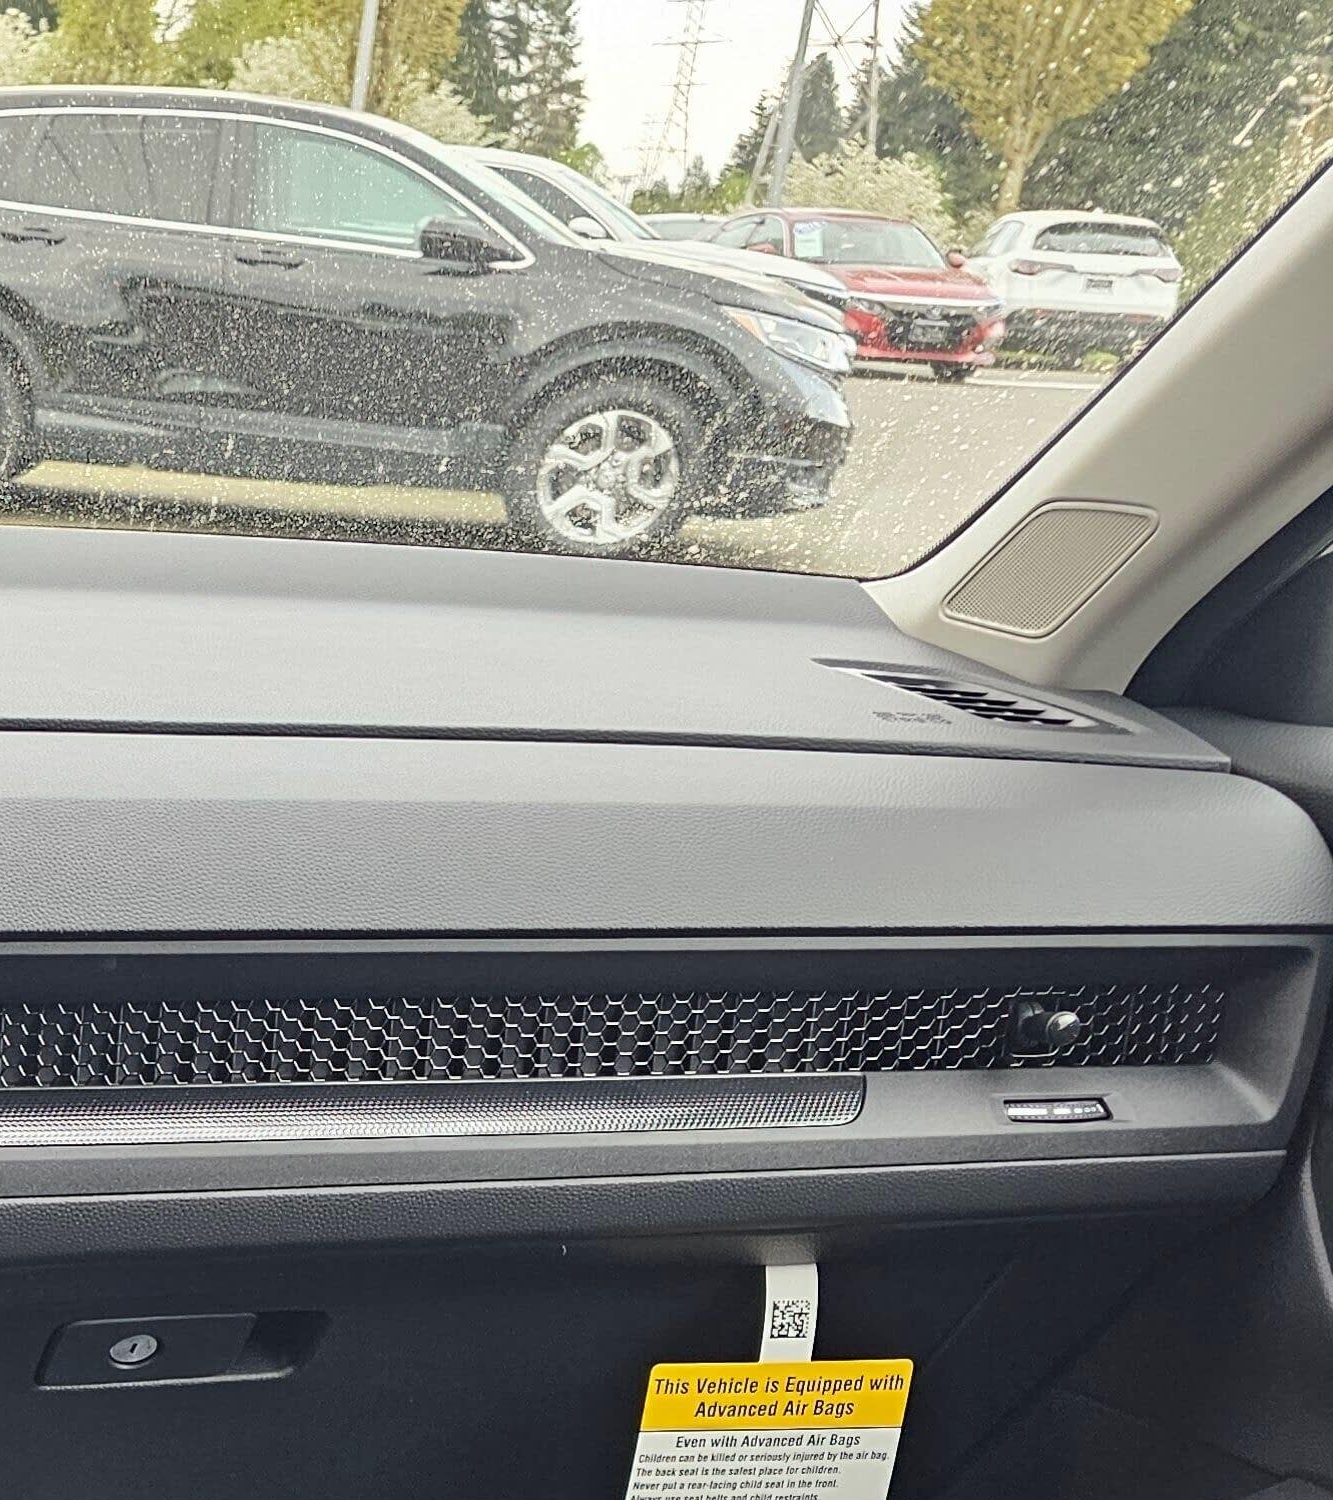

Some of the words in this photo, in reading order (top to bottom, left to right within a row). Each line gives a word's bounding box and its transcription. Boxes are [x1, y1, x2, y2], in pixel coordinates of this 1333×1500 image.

[654, 1378, 689, 1395] This
[696, 1377, 758, 1394] Vehicle
[765, 1377, 779, 1393] is
[785, 1375, 863, 1396] Equipped
[869, 1375, 904, 1391] with
[694, 1401, 777, 1418] Advanced
[783, 1400, 807, 1416] Air
[813, 1399, 854, 1419] Bags
[675, 1436, 707, 1448] Even
[710, 1436, 737, 1447] with
[741, 1434, 804, 1447] Advanced
[807, 1434, 826, 1446] Air
[829, 1434, 861, 1448] Bags
[639, 1453, 677, 1463] Children
[678, 1454, 695, 1463] can
[697, 1453, 708, 1462] be
[711, 1453, 736, 1462] killed
[738, 1453, 747, 1461] or
[750, 1452, 791, 1463] seriously
[793, 1452, 825, 1462] injured
[827, 1451, 837, 1462] by
[839, 1451, 853, 1460] the
[856, 1451, 868, 1460] air
[870, 1451, 889, 1461] bag.
[636, 1468, 652, 1477] The
[655, 1467, 676, 1476] back
[678, 1467, 698, 1476] seat
[701, 1467, 709, 1476] is
[712, 1467, 726, 1475] the
[728, 1466, 756, 1476] safest
[758, 1466, 783, 1477] place
[786, 1466, 799, 1475] for
[801, 1465, 841, 1474] children.
[633, 1482, 659, 1490] Never
[662, 1482, 677, 1491] put
[687, 1481, 737, 1491] rear-facing
[739, 1480, 763, 1489] child
[764, 1480, 784, 1488] seat
[786, 1480, 796, 1488] in
[798, 1480, 812, 1488] the
[815, 1479, 838, 1488] front.
